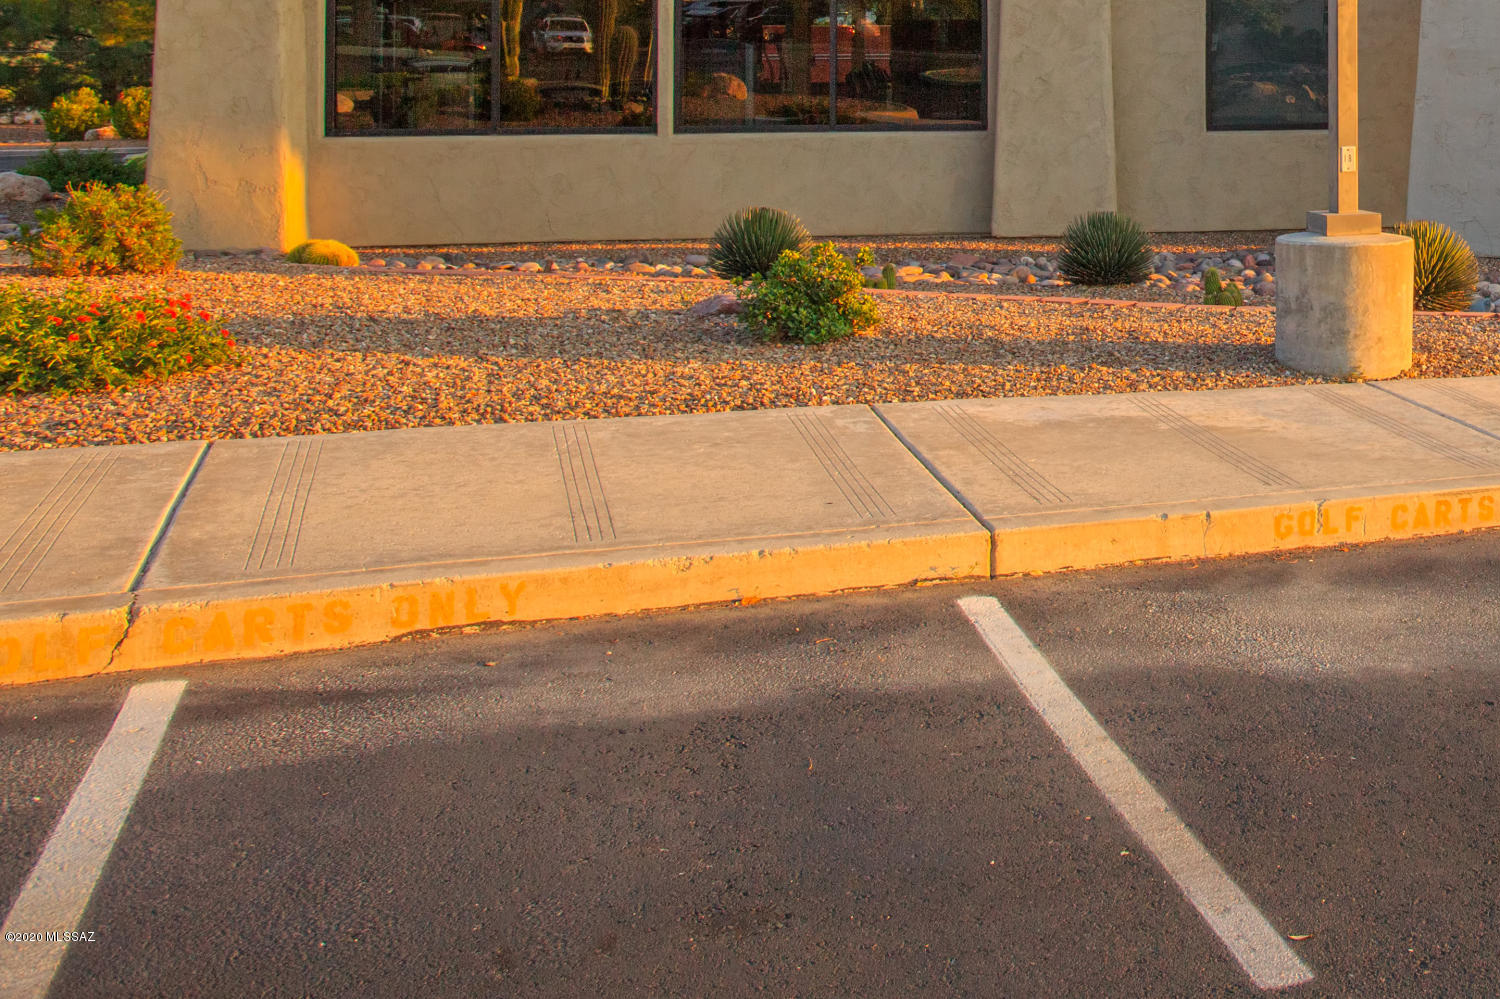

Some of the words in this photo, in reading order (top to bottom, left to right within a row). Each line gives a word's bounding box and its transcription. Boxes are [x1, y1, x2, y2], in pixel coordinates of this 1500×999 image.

[1273, 505, 1364, 540] GOLF
[1390, 495, 1495, 531] CARTS
[0, 625, 110, 674] OLF
[162, 599, 352, 656] CARTS
[390, 580, 527, 629] ONLY
